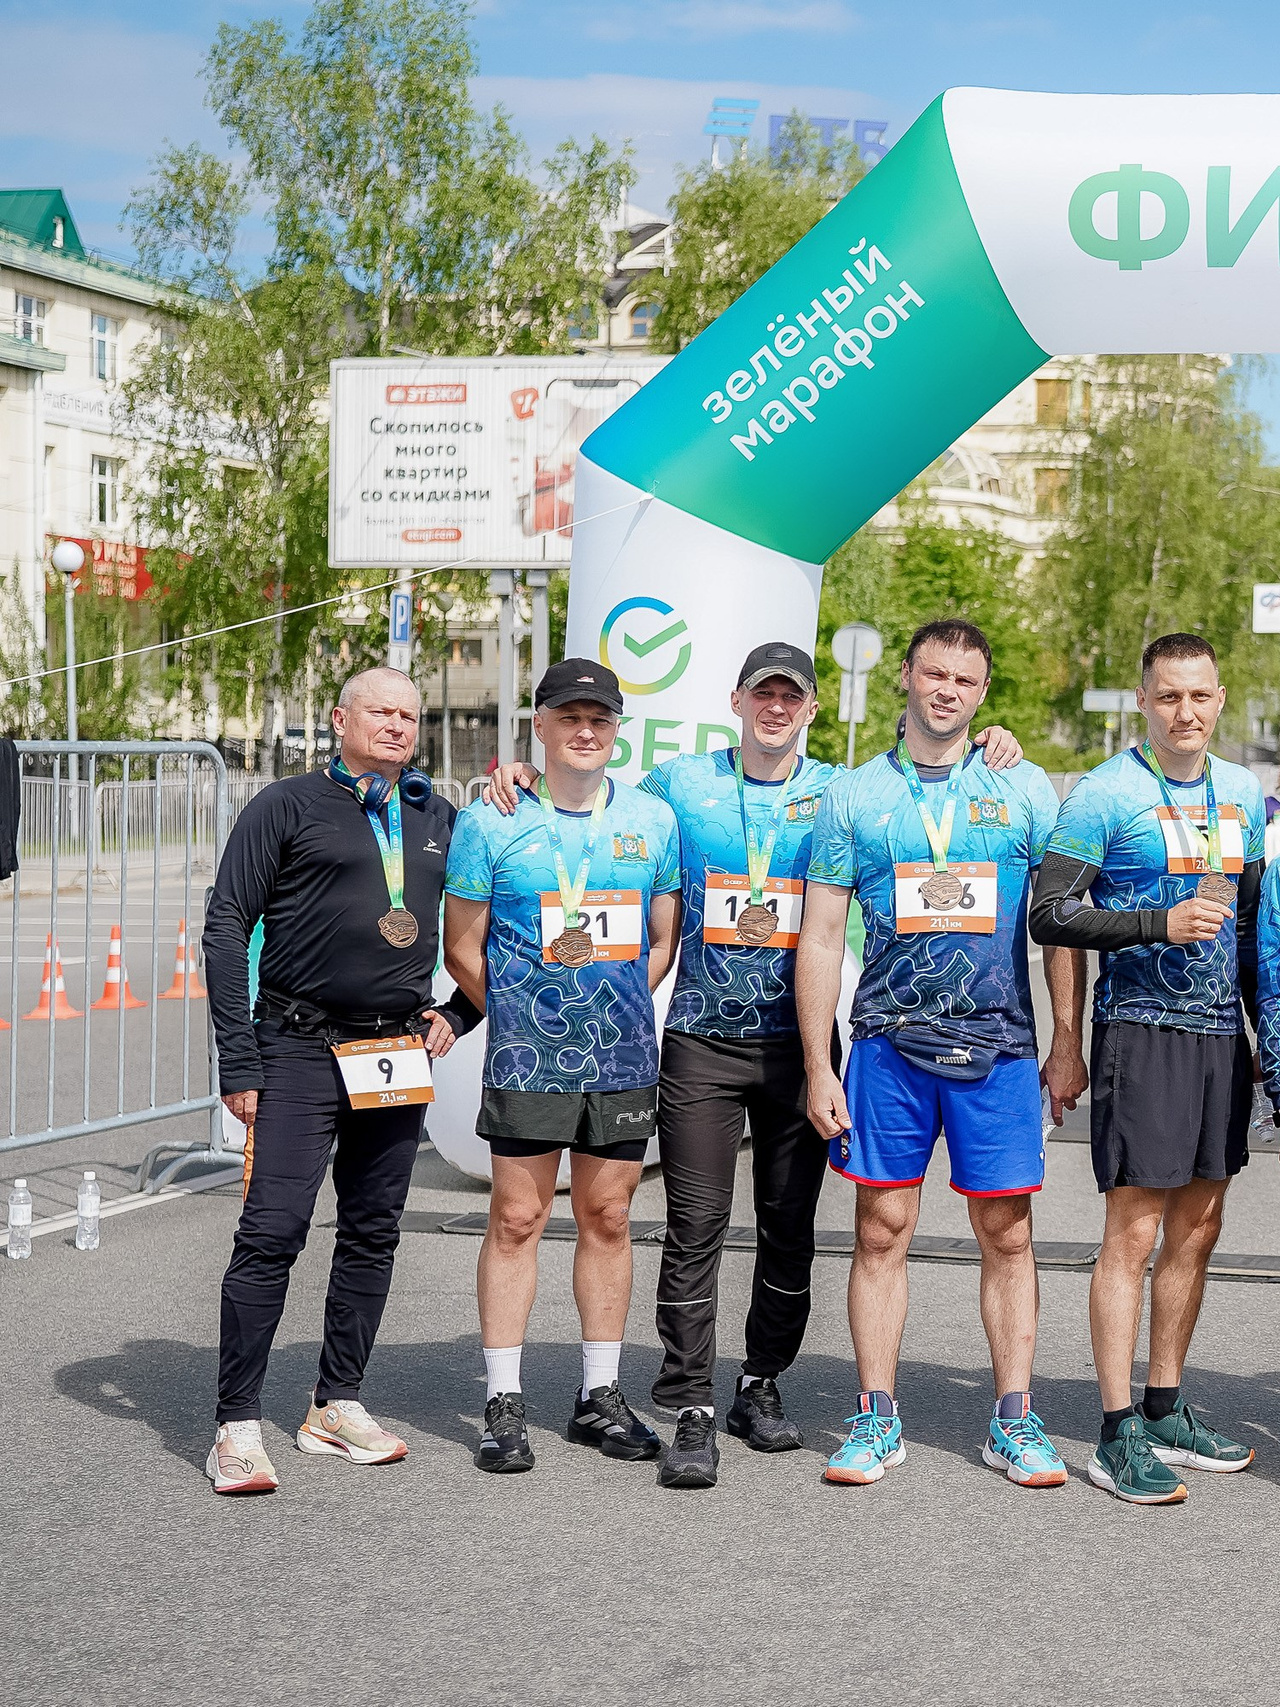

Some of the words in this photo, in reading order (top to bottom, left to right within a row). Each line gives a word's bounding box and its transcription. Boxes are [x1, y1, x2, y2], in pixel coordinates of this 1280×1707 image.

[702, 236, 893, 424] зелёный
[729, 280, 926, 462] марафон
[370, 416, 484, 434] Скопилось
[395, 444, 457, 457] много
[384, 465, 468, 484] квартир
[361, 489, 383, 502] со
[389, 488, 491, 504] скидками
[935, 1055, 968, 1065] PUMA
[377, 1058, 393, 1084] 9
